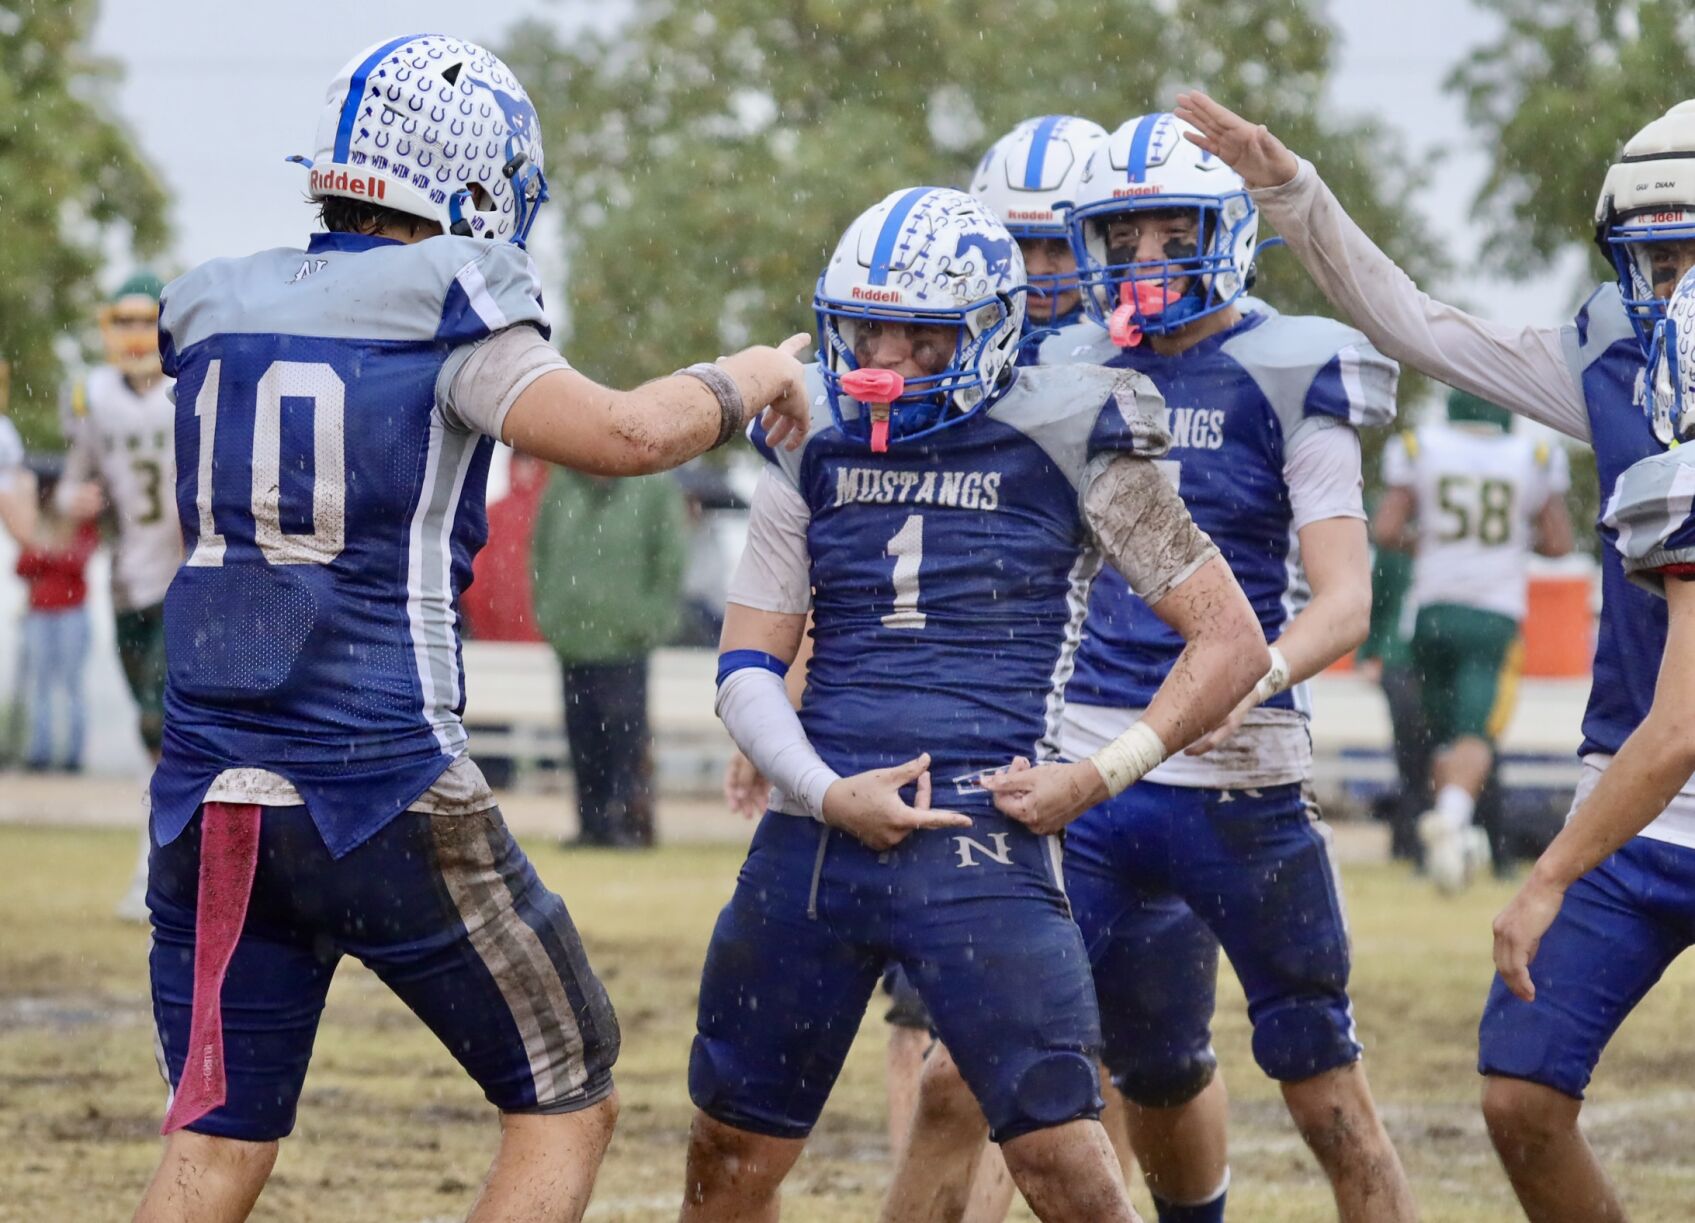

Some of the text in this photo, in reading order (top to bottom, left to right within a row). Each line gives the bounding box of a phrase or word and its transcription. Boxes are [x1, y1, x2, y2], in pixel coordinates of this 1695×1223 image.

[310, 169, 385, 200] Riddell
[351, 151, 367, 165] WIN
[371, 155, 388, 169] WIN
[392, 163, 410, 179] WIN
[412, 173, 430, 189] WIN
[429, 189, 446, 204] WIN
[470, 215, 485, 231] WIN
[852, 286, 899, 303] Riddell
[186, 358, 347, 567] 10
[130, 458, 164, 525] 3
[833, 466, 1002, 511] MUSTANGS
[1437, 473, 1511, 547] 58
[881, 514, 927, 630] 1
[951, 832, 1015, 868] N
